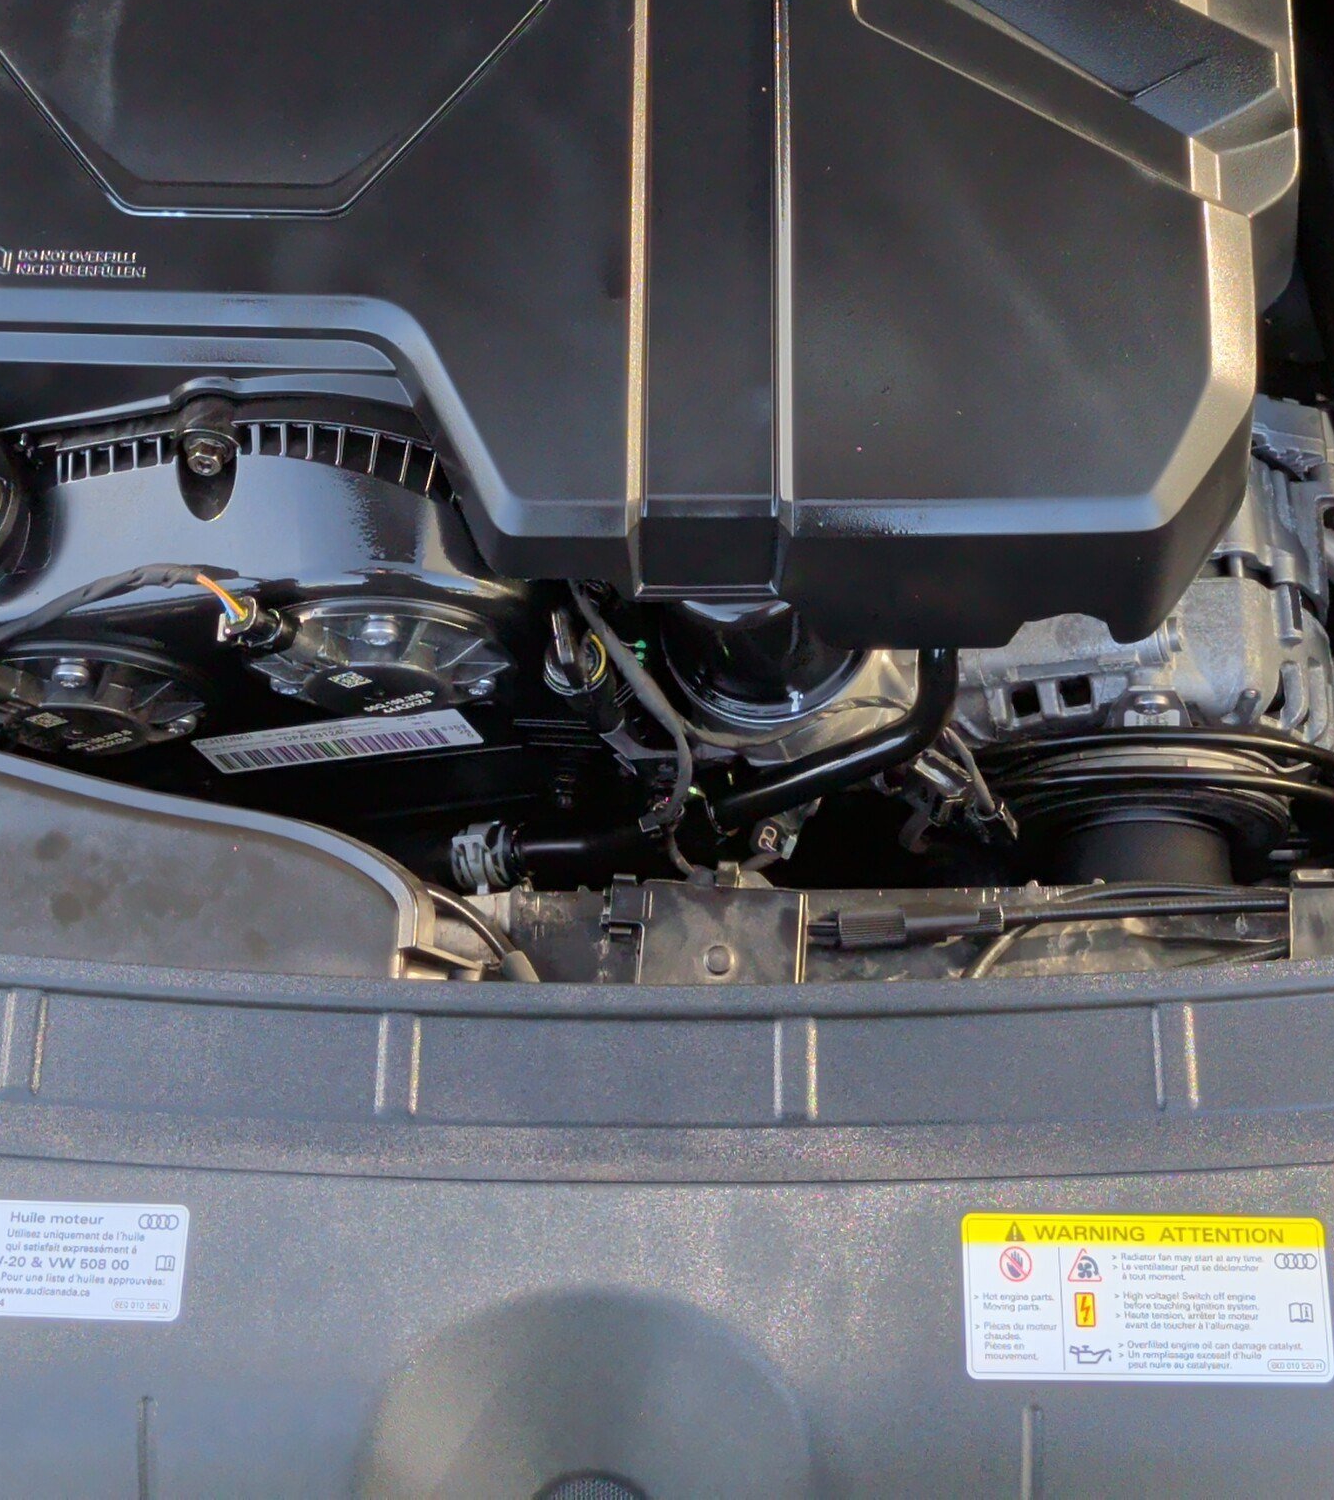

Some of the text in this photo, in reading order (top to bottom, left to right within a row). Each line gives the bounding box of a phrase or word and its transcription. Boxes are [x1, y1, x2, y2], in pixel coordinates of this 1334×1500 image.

[10, 1212, 104, 1225] Huile moteur
[7, 1229, 40, 1238] Utilisez
[43, 1230, 99, 1241] uniquement
[102, 1231, 114, 1241] de
[1034, 1225, 1284, 1244] WARNING ATTENTION
[5, 1242, 21, 1251] qui
[23, 1243, 60, 1252] satisfait
[31, 1257, 42, 1267] &
[49, 1258, 76, 1269] VW
[80, 1259, 106, 1270] 508
[111, 1260, 129, 1270] 00
[1121, 1253, 1155, 1261] Radiator
[1175, 1255, 1191, 1264] may
[1195, 1254, 1213, 1262] start
[1226, 1256, 1241, 1264] any
[1134, 1263, 1178, 1271] ventilateur
[1181, 1264, 1199, 1273] peut
[1, 1272, 23, 1281] Pour
[25, 1274, 43, 1282] une
[46, 1273, 65, 1282] liste
[0, 1287, 90, 1297] www.audicanada.ca
[1123, 1292, 1143, 1302] High
[1183, 1293, 1211, 1301] Switch
[1214, 1293, 1225, 1301] off
[1227, 1294, 1256, 1302] engine
[1000, 1294, 1029, 1302] engine
[1031, 1294, 1054, 1303] parts.
[983, 1302, 1041, 1312] Moving parts.
[1124, 1302, 1151, 1310] before
[1154, 1302, 1190, 1311] touching
[1193, 1303, 1225, 1311] ignition
[1127, 1341, 1168, 1349] Overfilled
[1171, 1342, 1200, 1351] engine
[1232, 1342, 1266, 1351] damage
[1143, 1352, 1194, 1361] remplissage
[1128, 1362, 1147, 1370] peut
[1150, 1361, 1172, 1369] nuire
